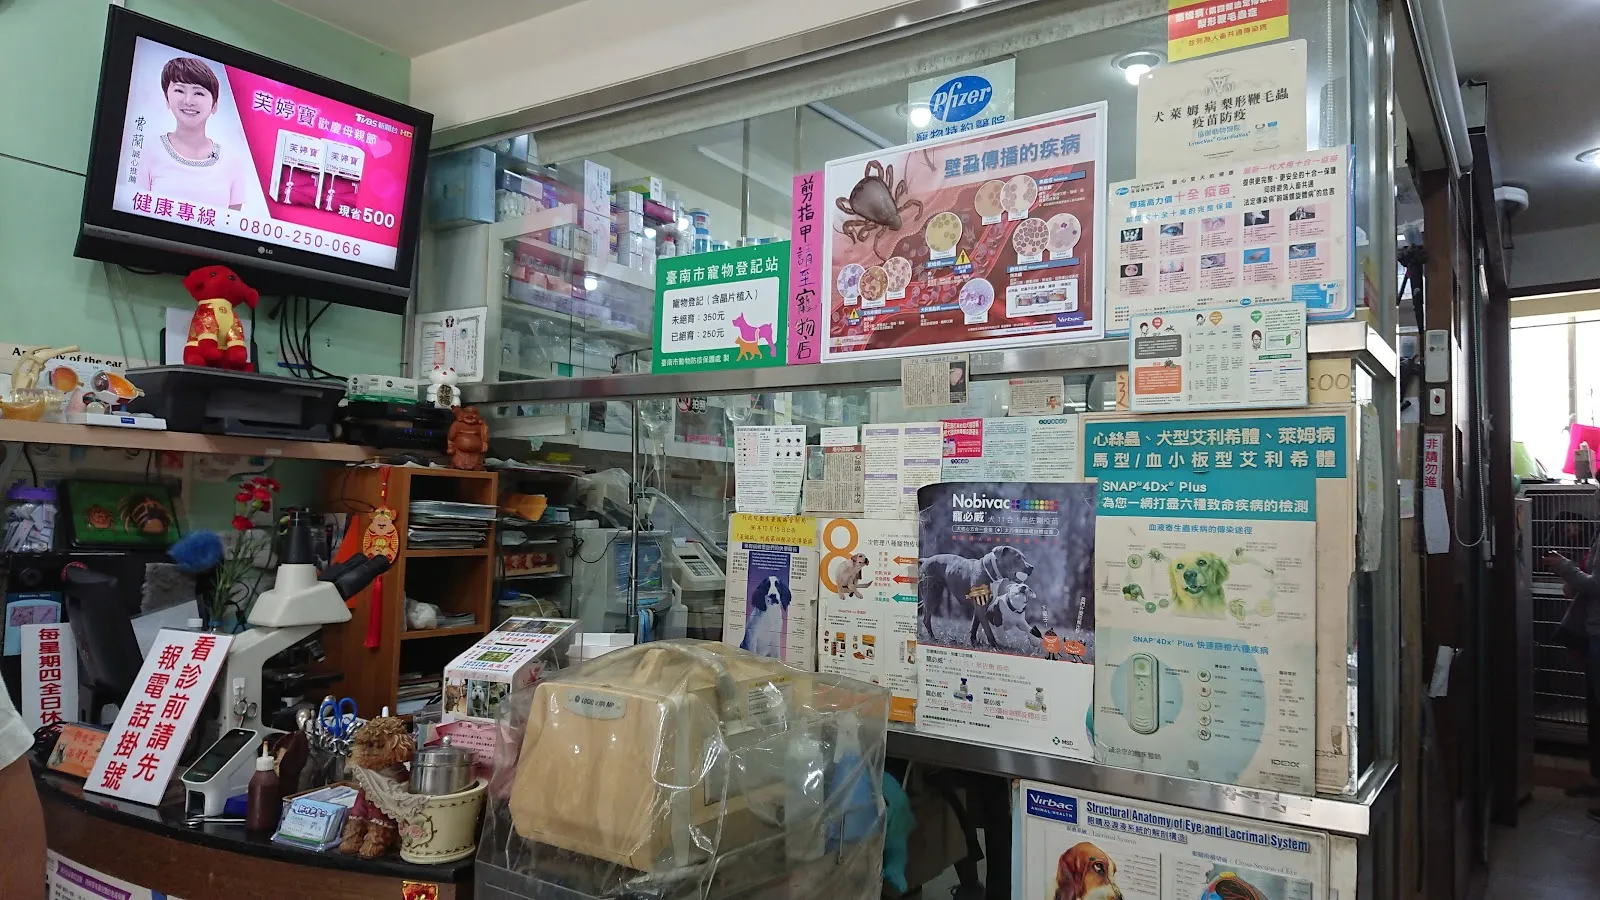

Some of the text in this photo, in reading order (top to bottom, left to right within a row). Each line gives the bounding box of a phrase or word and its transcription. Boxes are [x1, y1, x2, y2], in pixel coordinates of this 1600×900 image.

[253, 91, 317, 127] 芙婷寶
[932, 82, 992, 122] Pfizer
[1191, 108, 1247, 129] 疫苗防疫
[317, 116, 378, 146] 歡慶母親節
[399, 129, 413, 139] HD
[289, 143, 319, 158] 芙婷寶
[330, 151, 360, 167] 芙婷寶
[238, 217, 362, 257] 0800-250-066
[665, 255, 779, 286] 臺南市寵物登記站
[69, 354, 83, 362] of
[84, 354, 102, 365] the
[105, 360, 123, 368] ear
[1092, 426, 1336, 448] 心絲蟲、犬型艾利希體、萊姆病
[1092, 449, 1336, 470] 馬型/血小板型艾利希體
[1424, 438, 1439, 488] 非請勿進
[1179, 481, 1207, 493] Plus
[952, 492, 1011, 509] Nobivac
[1101, 496, 1309, 514] 為您一網打盡六種致命疾病的檢測
[1177, 640, 1194, 648] Plus
[100, 644, 184, 790] 報電話掛號
[132, 635, 216, 782] 看診前請先
[1029, 793, 1074, 811] Virbac
[1086, 801, 1310, 851] Structural Anatomy of Eye and Lacrimal System
